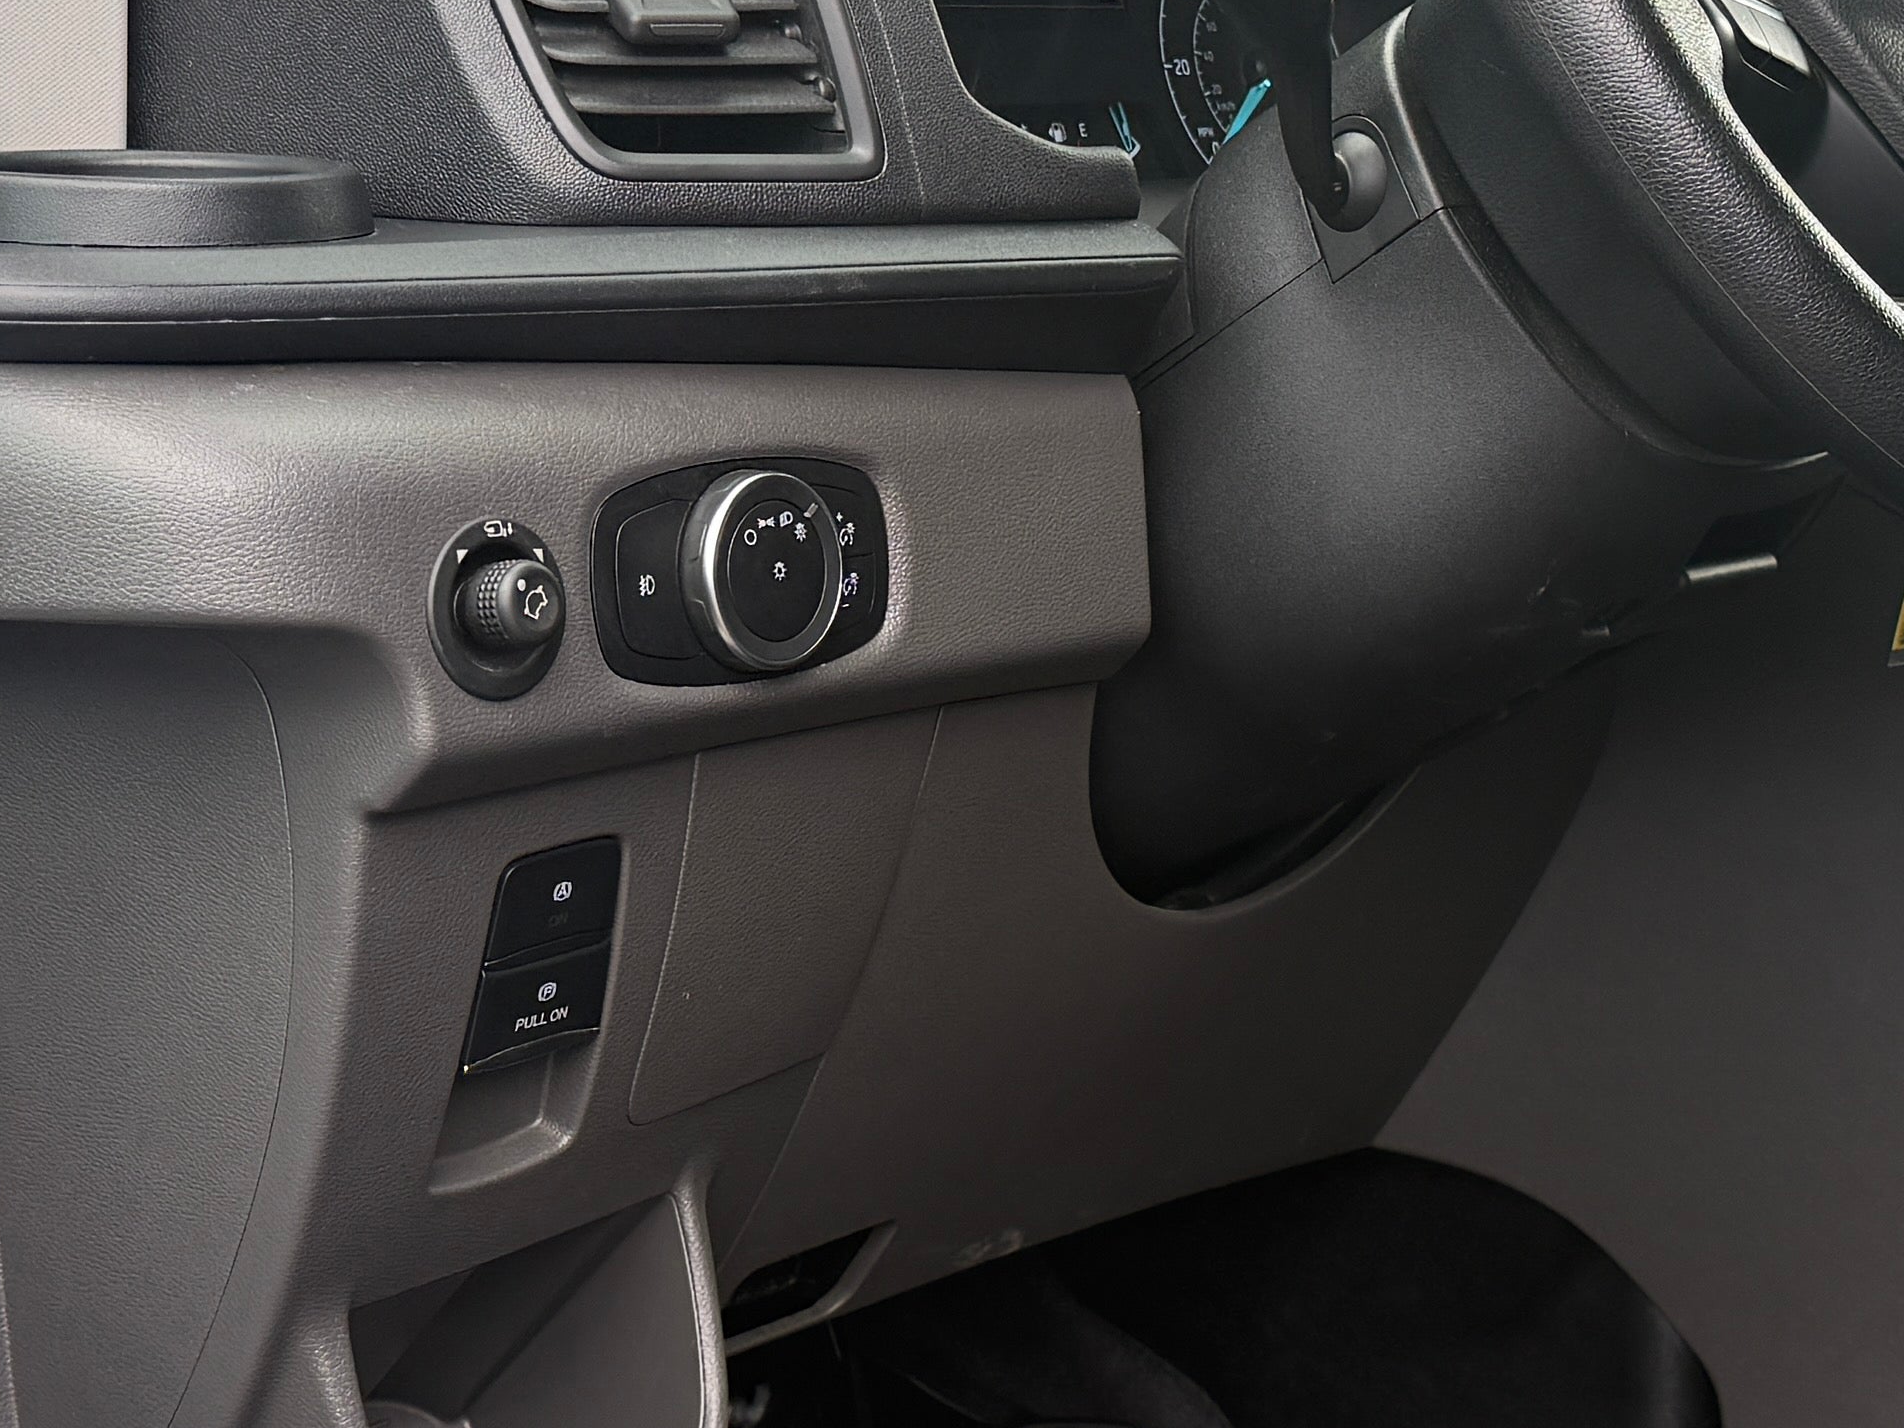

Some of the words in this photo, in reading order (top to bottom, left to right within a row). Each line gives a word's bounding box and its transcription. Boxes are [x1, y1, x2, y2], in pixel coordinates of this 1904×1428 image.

[1173, 58, 1191, 76] 20
[1078, 122, 1088, 139] E
[514, 1012, 547, 1032] PULL
[550, 1006, 569, 1022] ON
